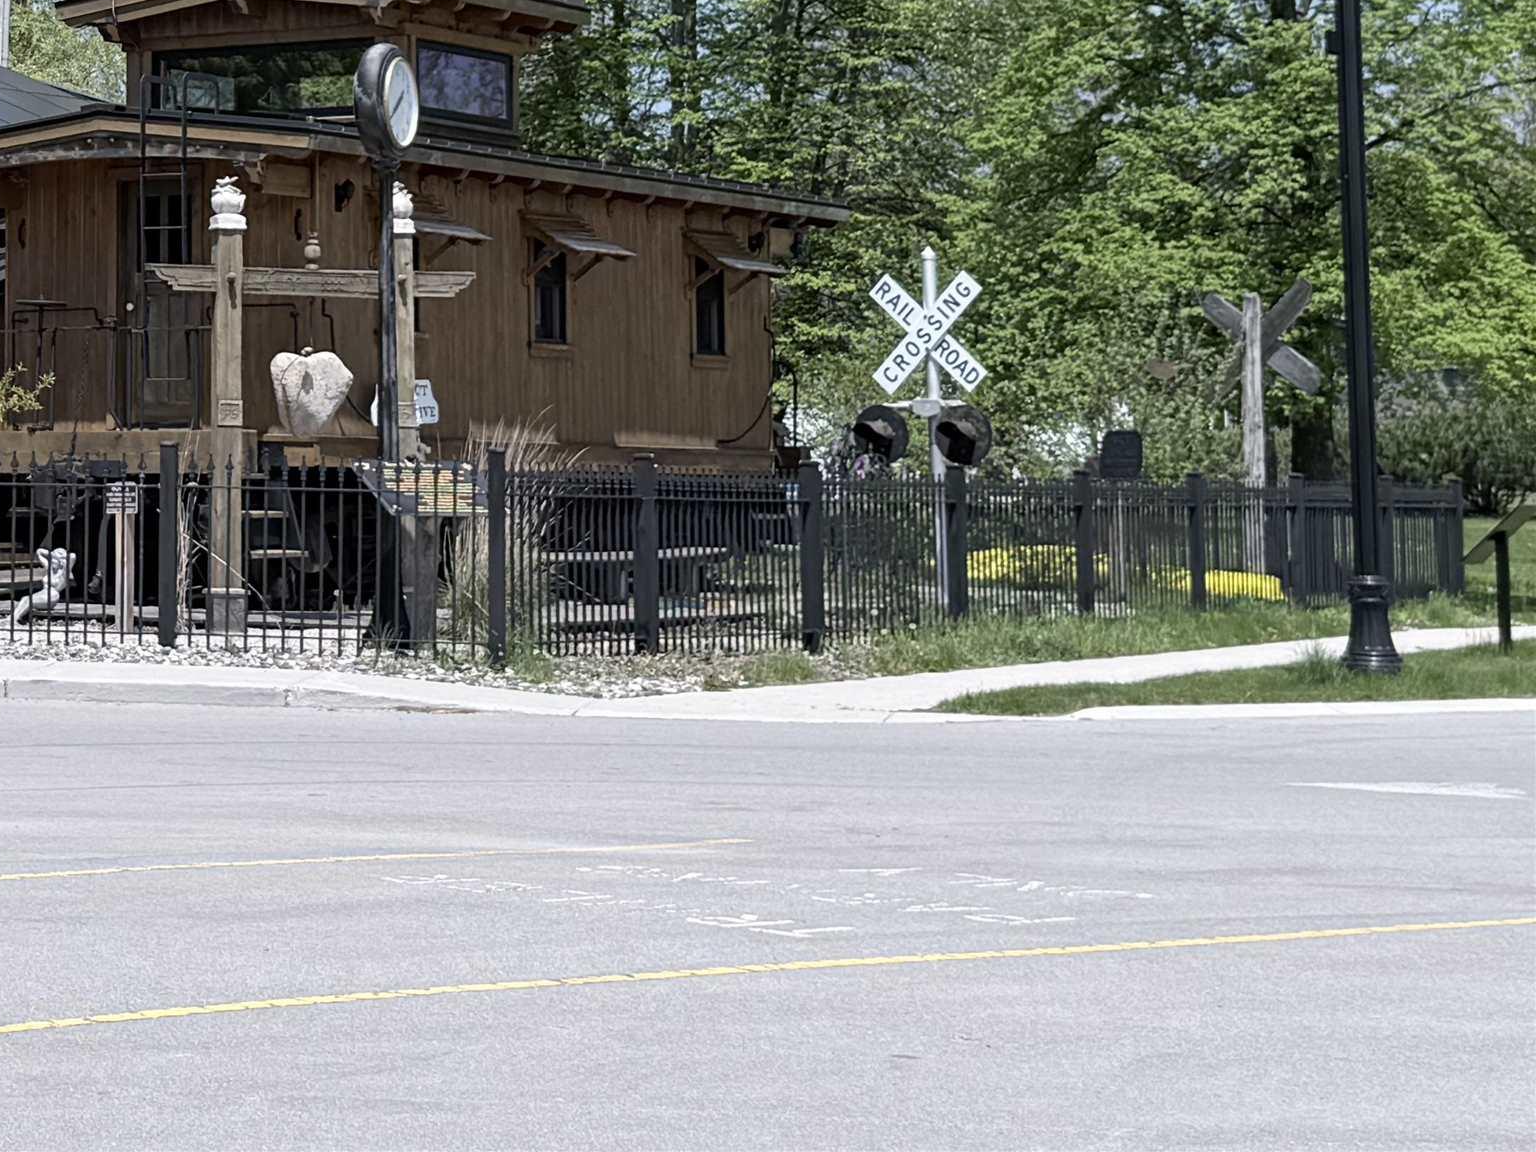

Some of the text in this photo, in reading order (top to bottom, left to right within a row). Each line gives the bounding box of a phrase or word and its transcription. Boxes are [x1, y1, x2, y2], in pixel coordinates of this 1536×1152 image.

[875, 281, 980, 384] RAIL ROAD
[883, 281, 971, 382] CROSSING
